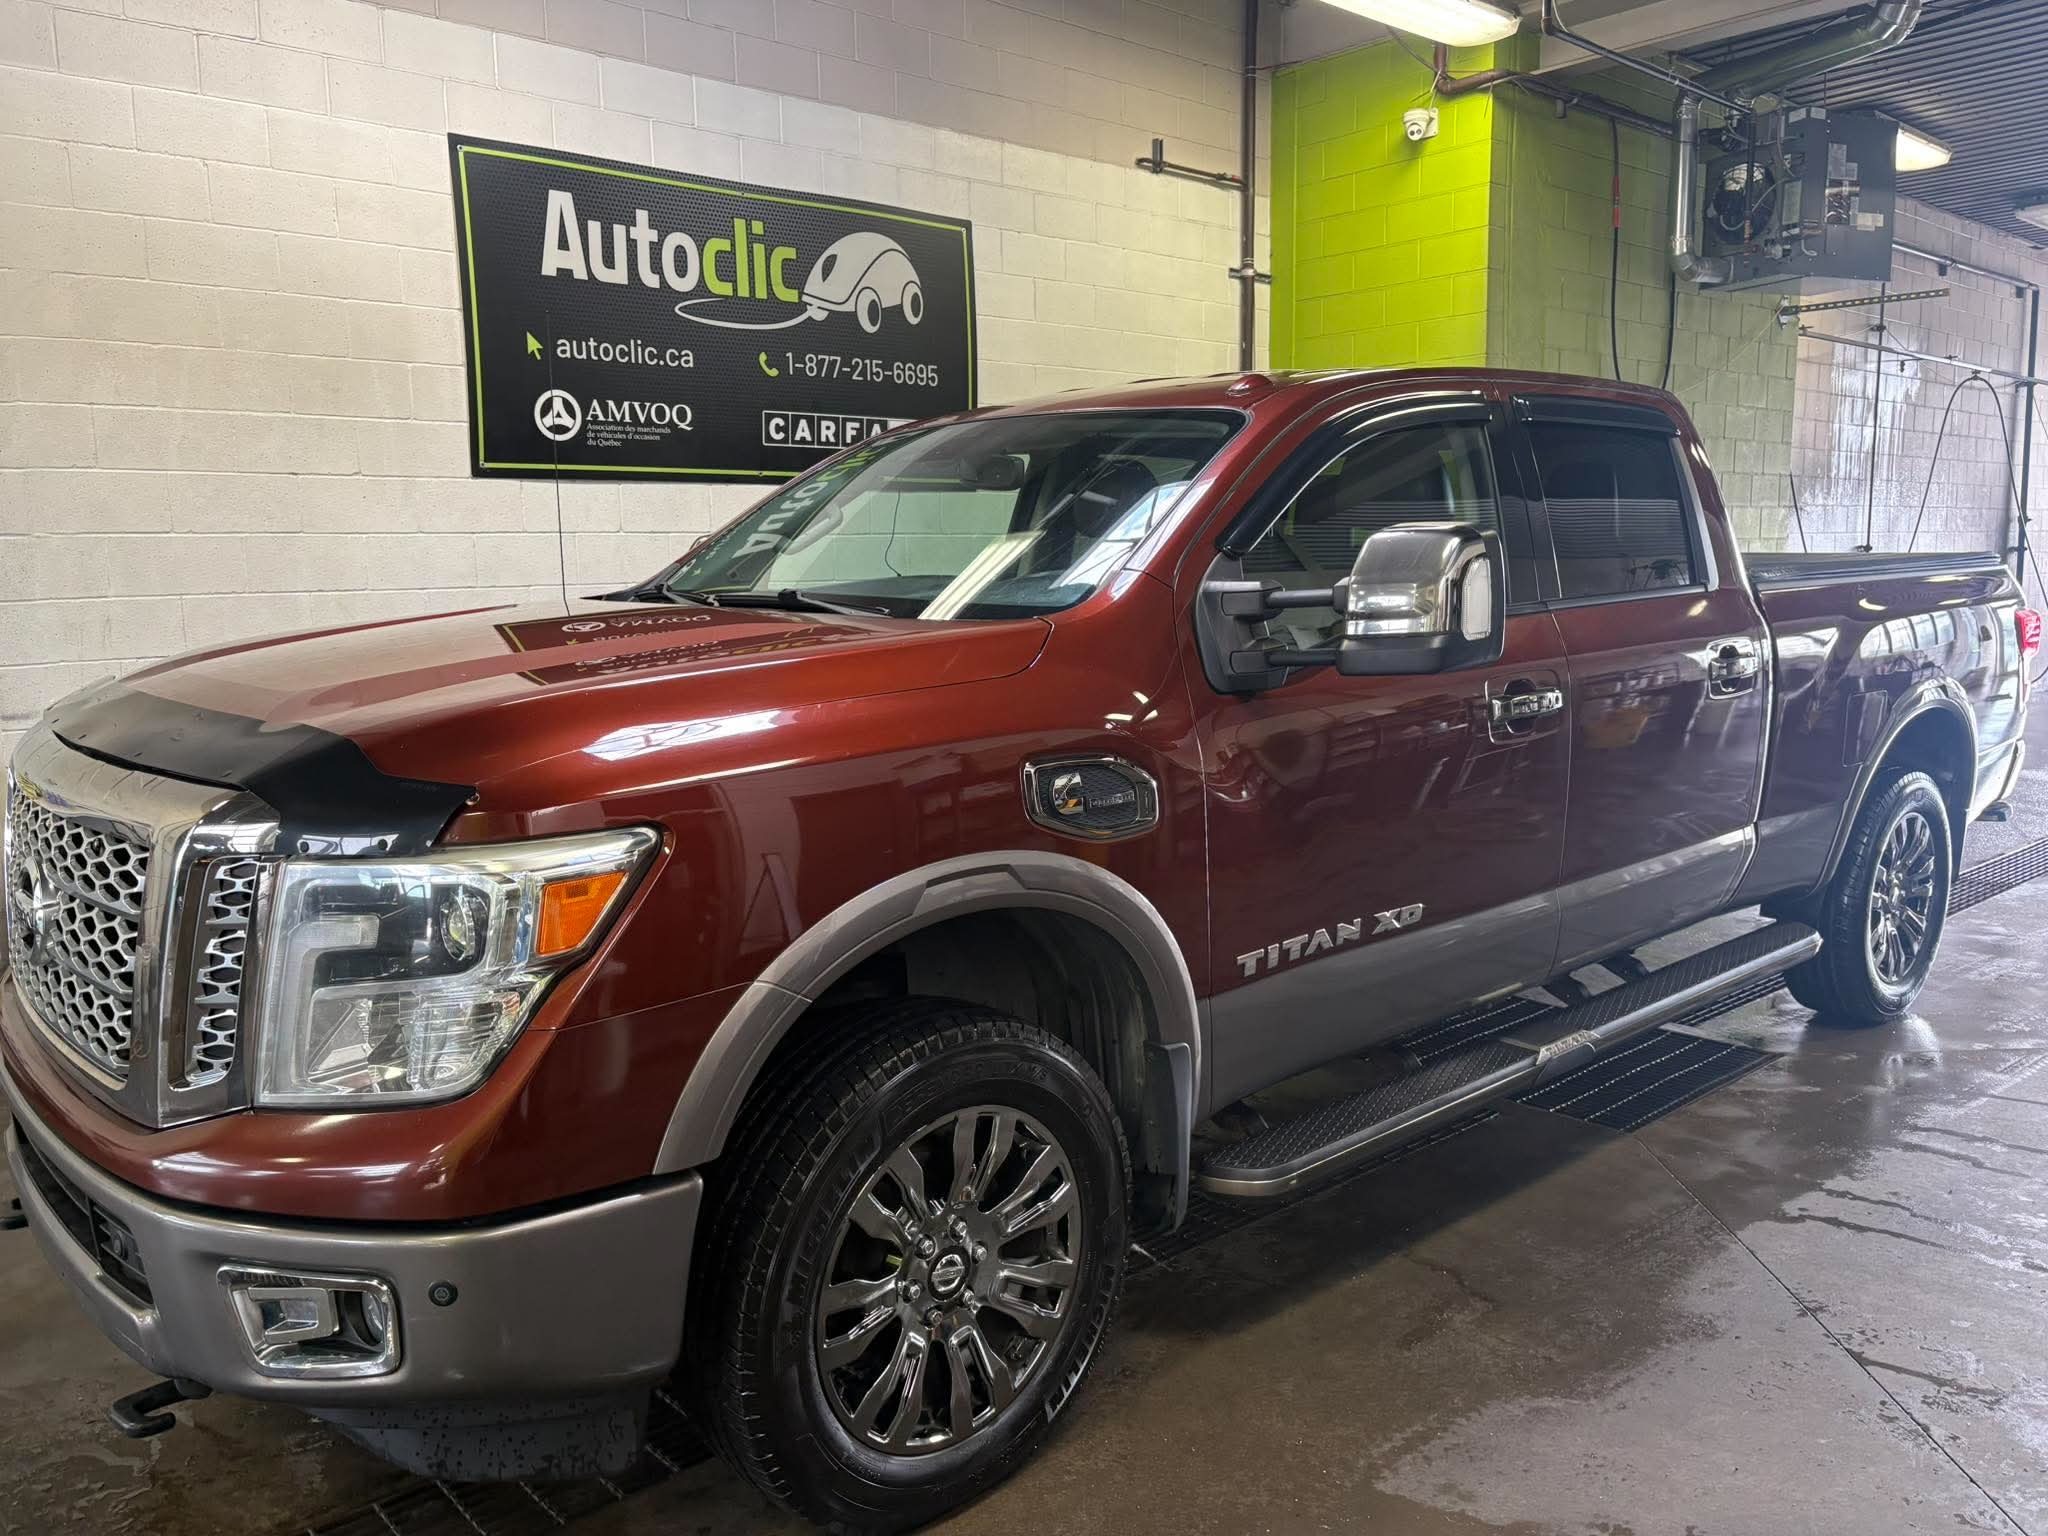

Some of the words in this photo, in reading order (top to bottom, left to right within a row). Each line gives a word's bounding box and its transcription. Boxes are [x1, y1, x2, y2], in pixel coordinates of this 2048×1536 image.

[541, 189, 799, 303] Autoclic
[556, 337, 694, 368] autoclic.ca
[786, 352, 939, 387] 1-877-215-6695
[585, 399, 693, 431] AMVOQ
[586, 423, 623, 432] Association
[768, 417, 884, 444] CARFA
[596, 431, 626, 439] véhicules
[597, 439, 622, 447] Québec
[1236, 918, 1362, 978] TITAN
[1371, 903, 1425, 936] XD
